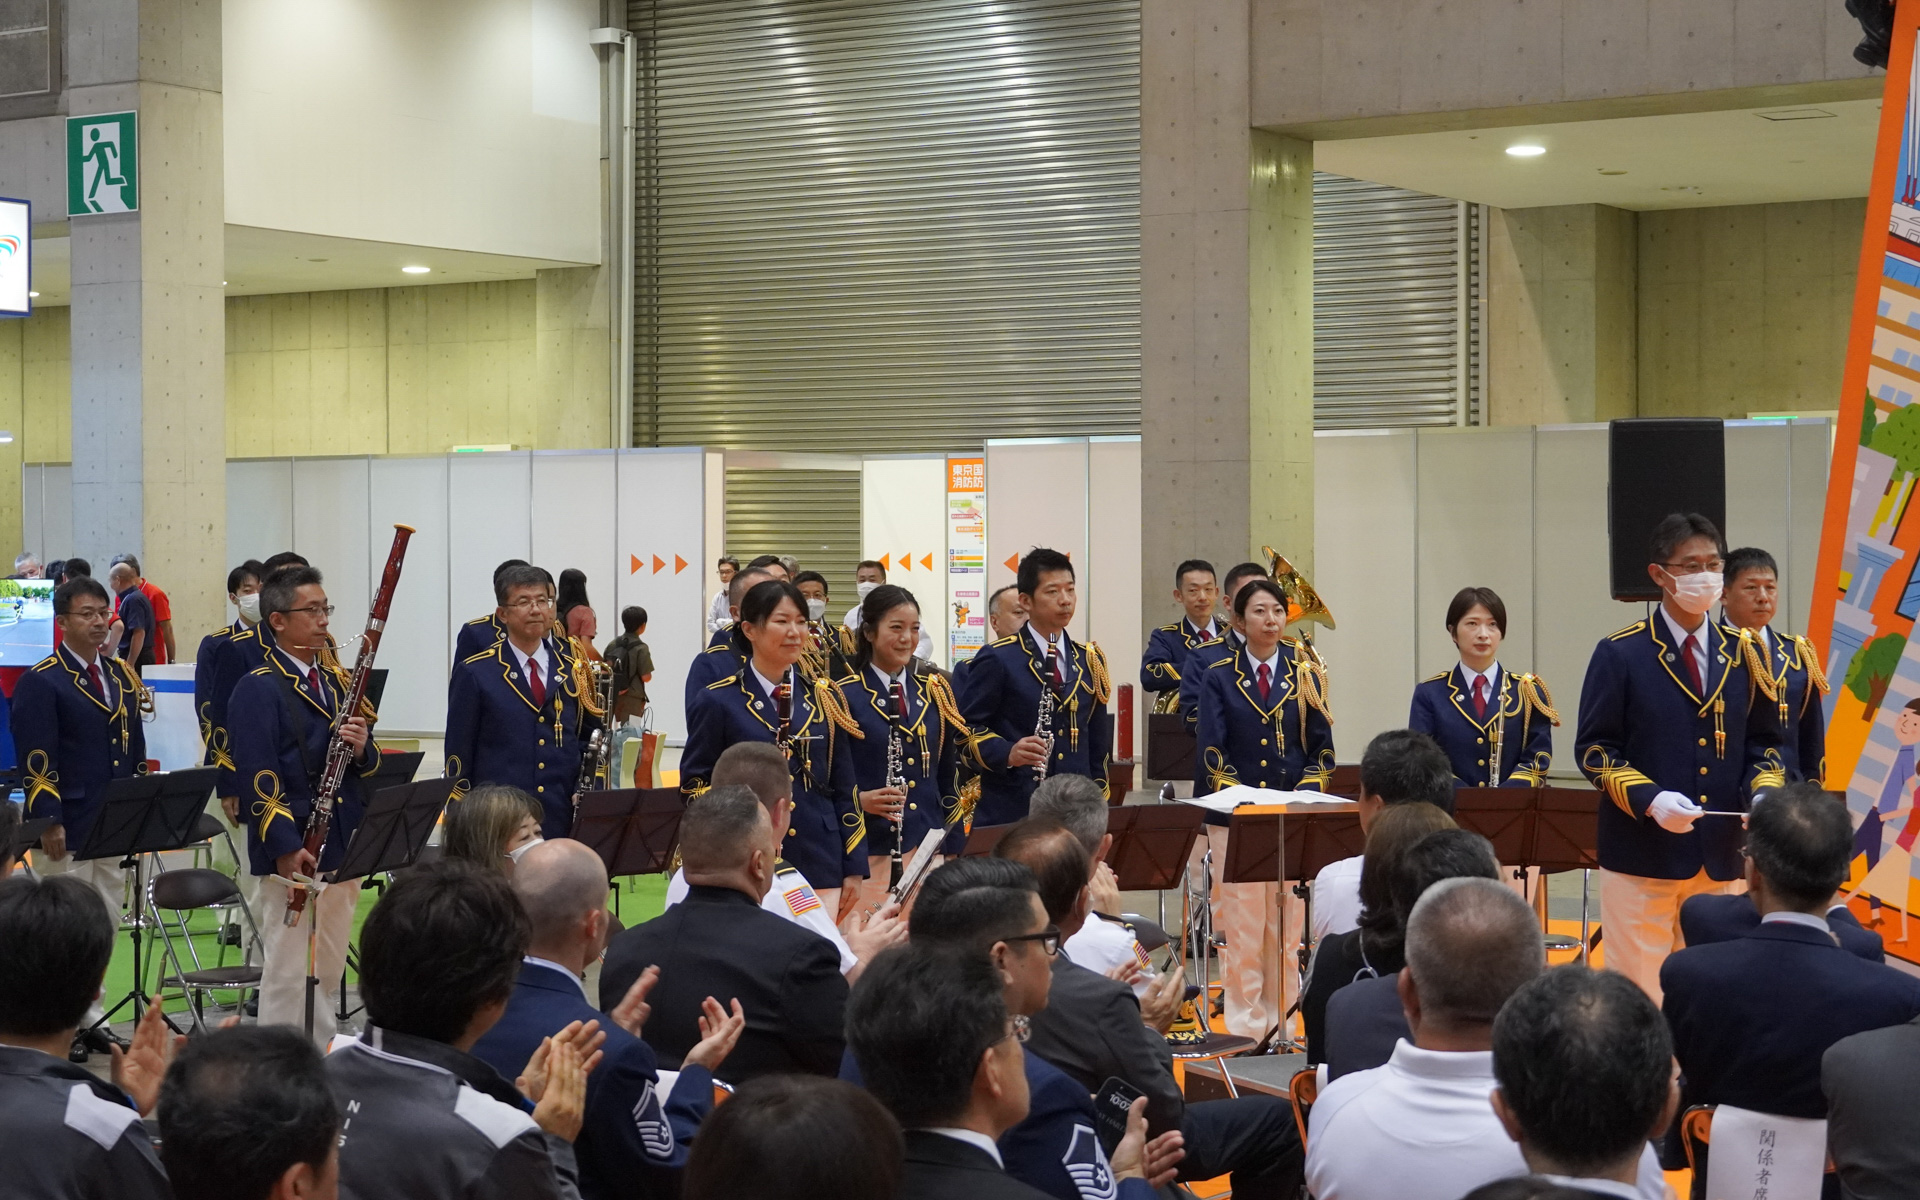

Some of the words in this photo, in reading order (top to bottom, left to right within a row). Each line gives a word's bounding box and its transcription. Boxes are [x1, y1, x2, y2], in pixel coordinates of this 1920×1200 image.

[952, 464, 983, 476] 東京国
[952, 477, 983, 489] 消防防
[1753, 1129, 1776, 1200] 関係者席
